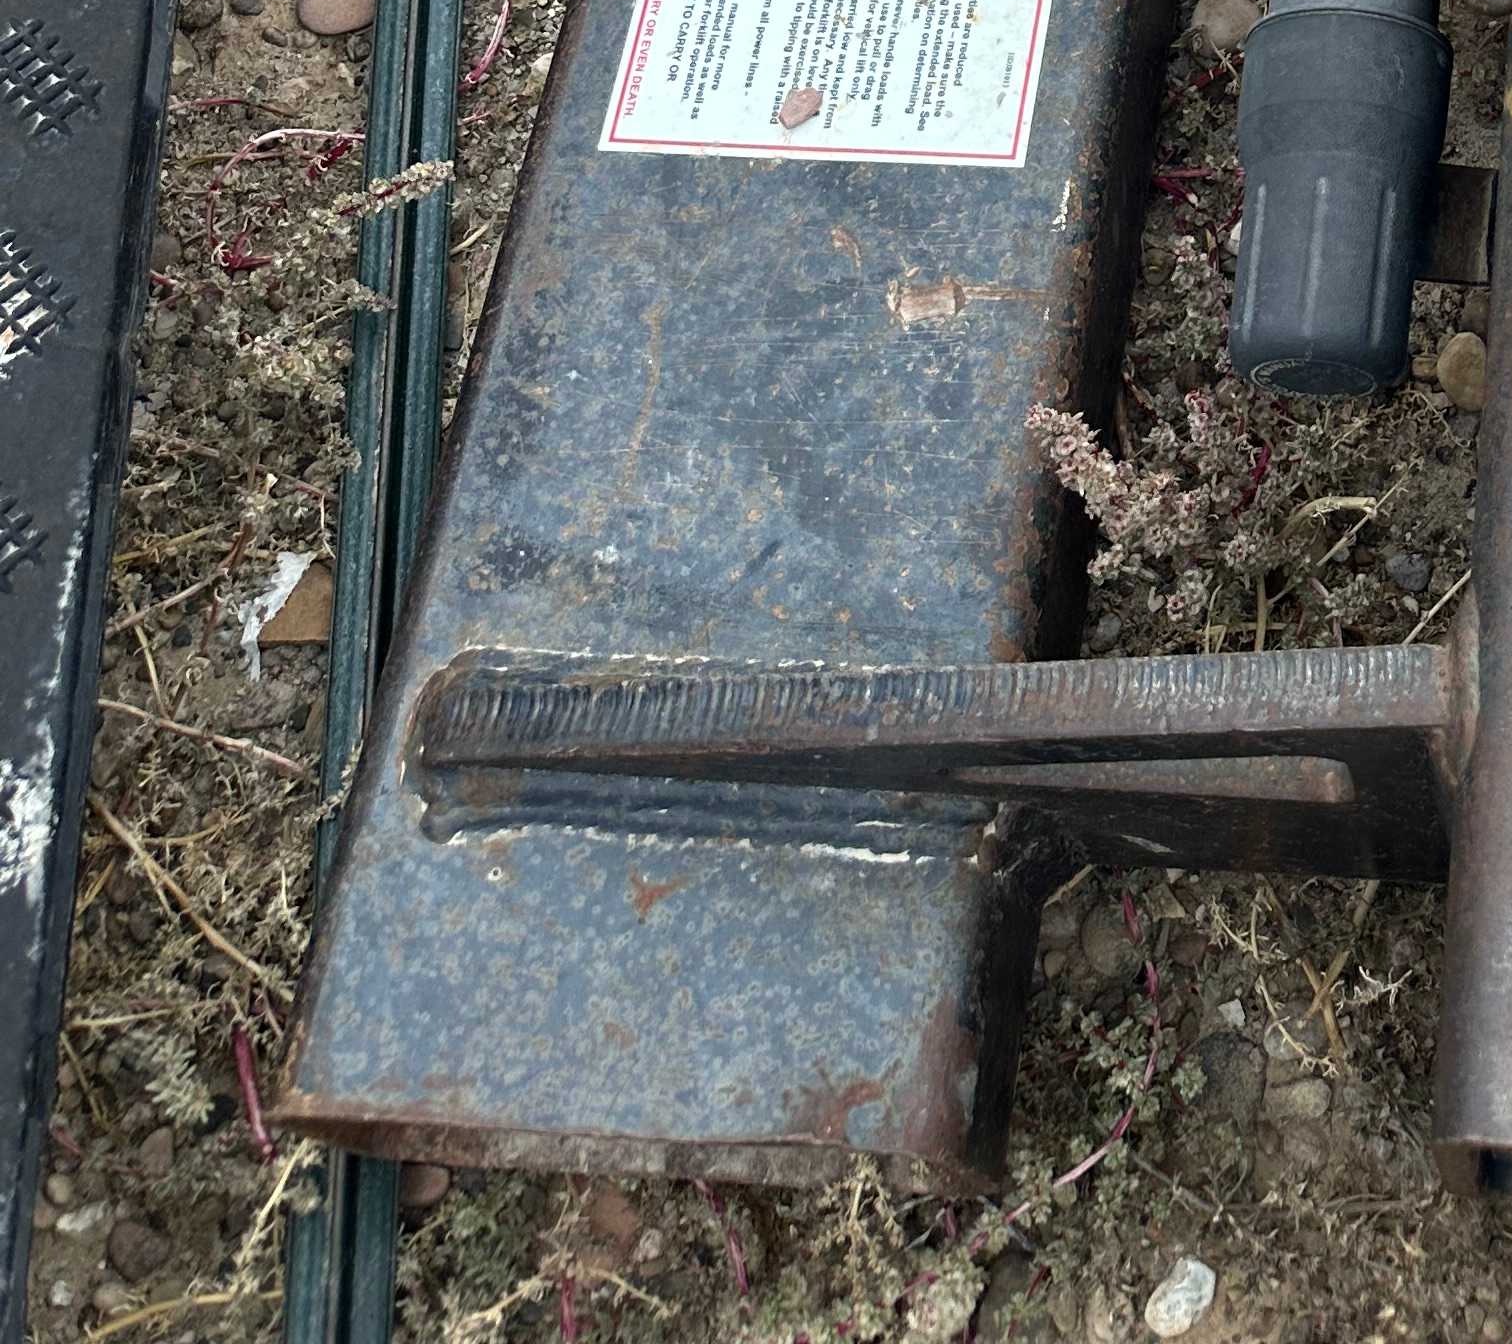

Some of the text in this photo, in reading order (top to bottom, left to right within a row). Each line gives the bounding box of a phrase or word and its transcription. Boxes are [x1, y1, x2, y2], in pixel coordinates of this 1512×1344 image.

[681, 2, 695, 19] TO
[643, 18, 656, 37] OR
[670, 21, 690, 62] CARRY
[634, 39, 651, 72] EVEN
[665, 63, 679, 82] OR
